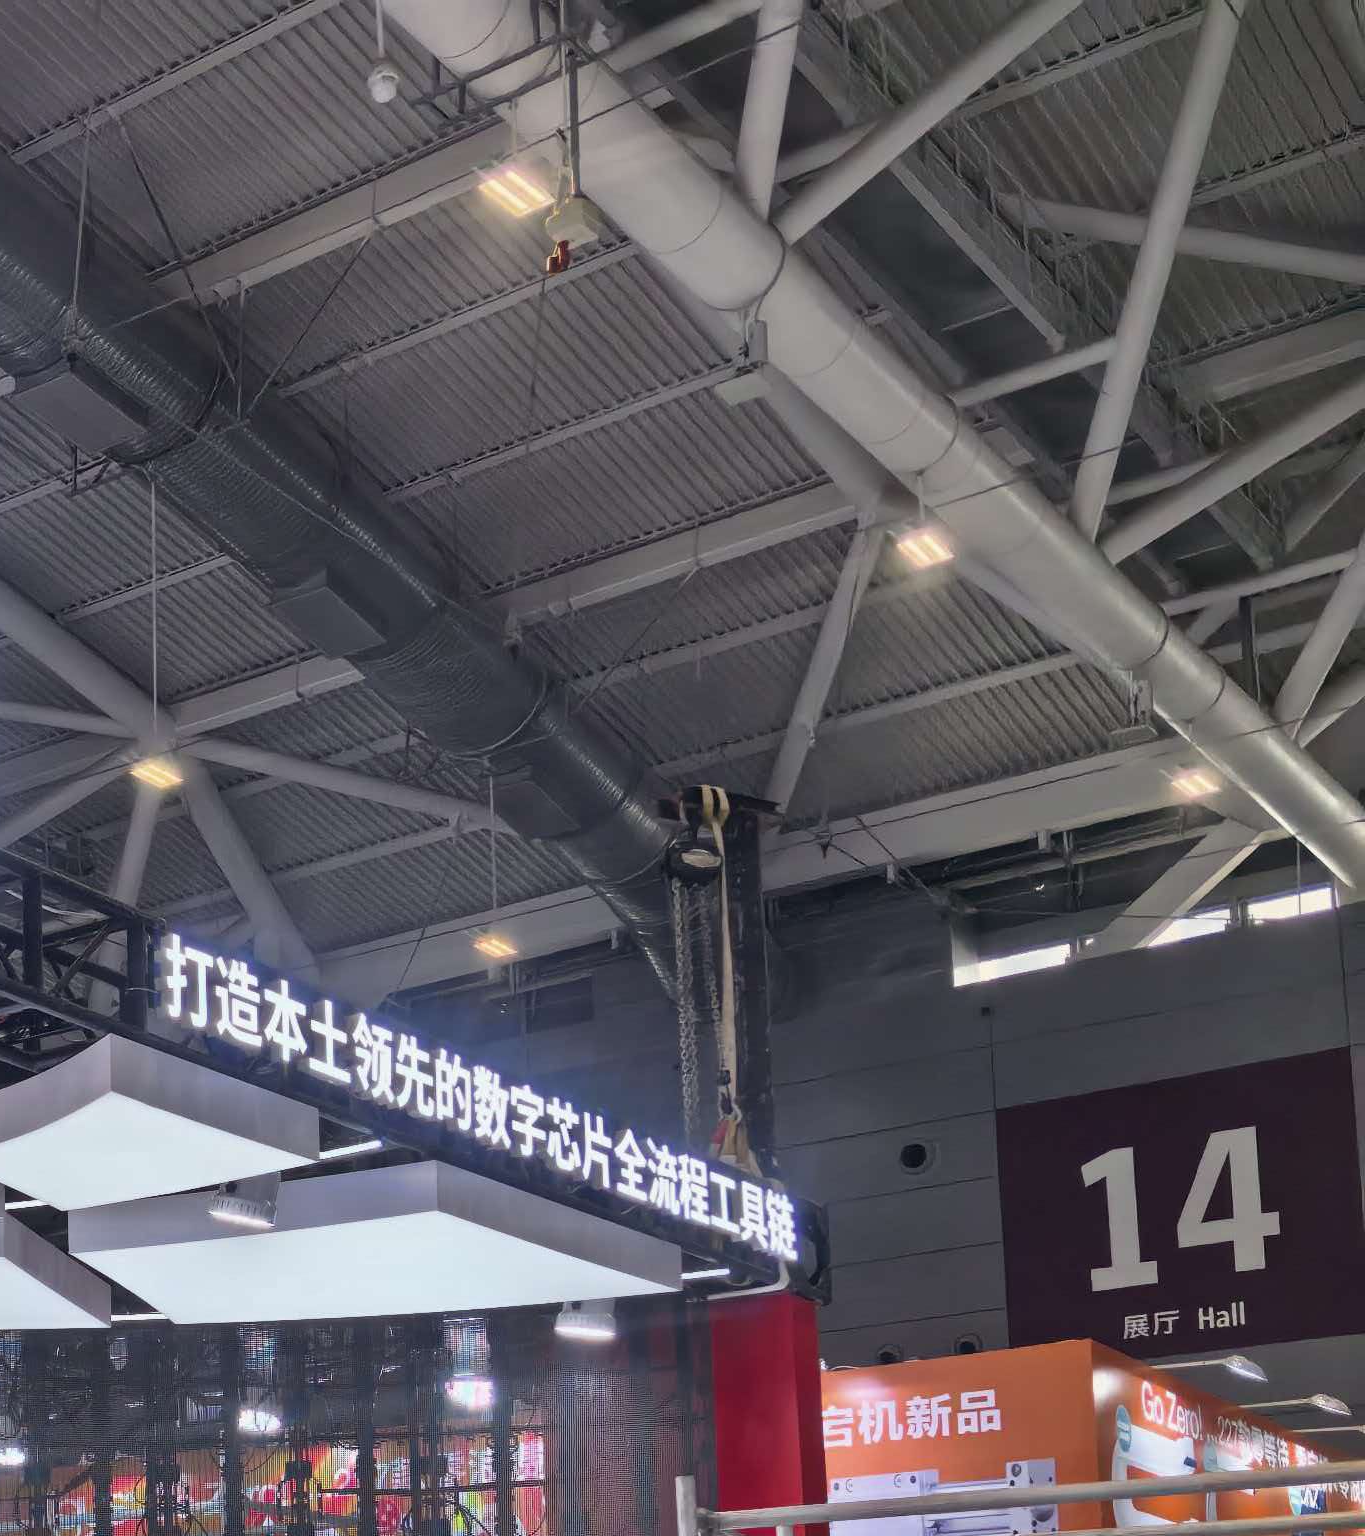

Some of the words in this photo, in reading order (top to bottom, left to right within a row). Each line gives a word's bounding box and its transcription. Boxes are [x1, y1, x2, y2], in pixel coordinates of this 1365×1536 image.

[164, 933, 797, 1261] 打造本土领先的数字芯片全流程工具链
[1081, 1126, 1280, 1291] 14
[1123, 1310, 1180, 1339] 展厅
[1197, 1301, 1246, 1330] Hall
[1141, 1380, 1163, 1425] Go
[1166, 1391, 1203, 1441] Zero!
